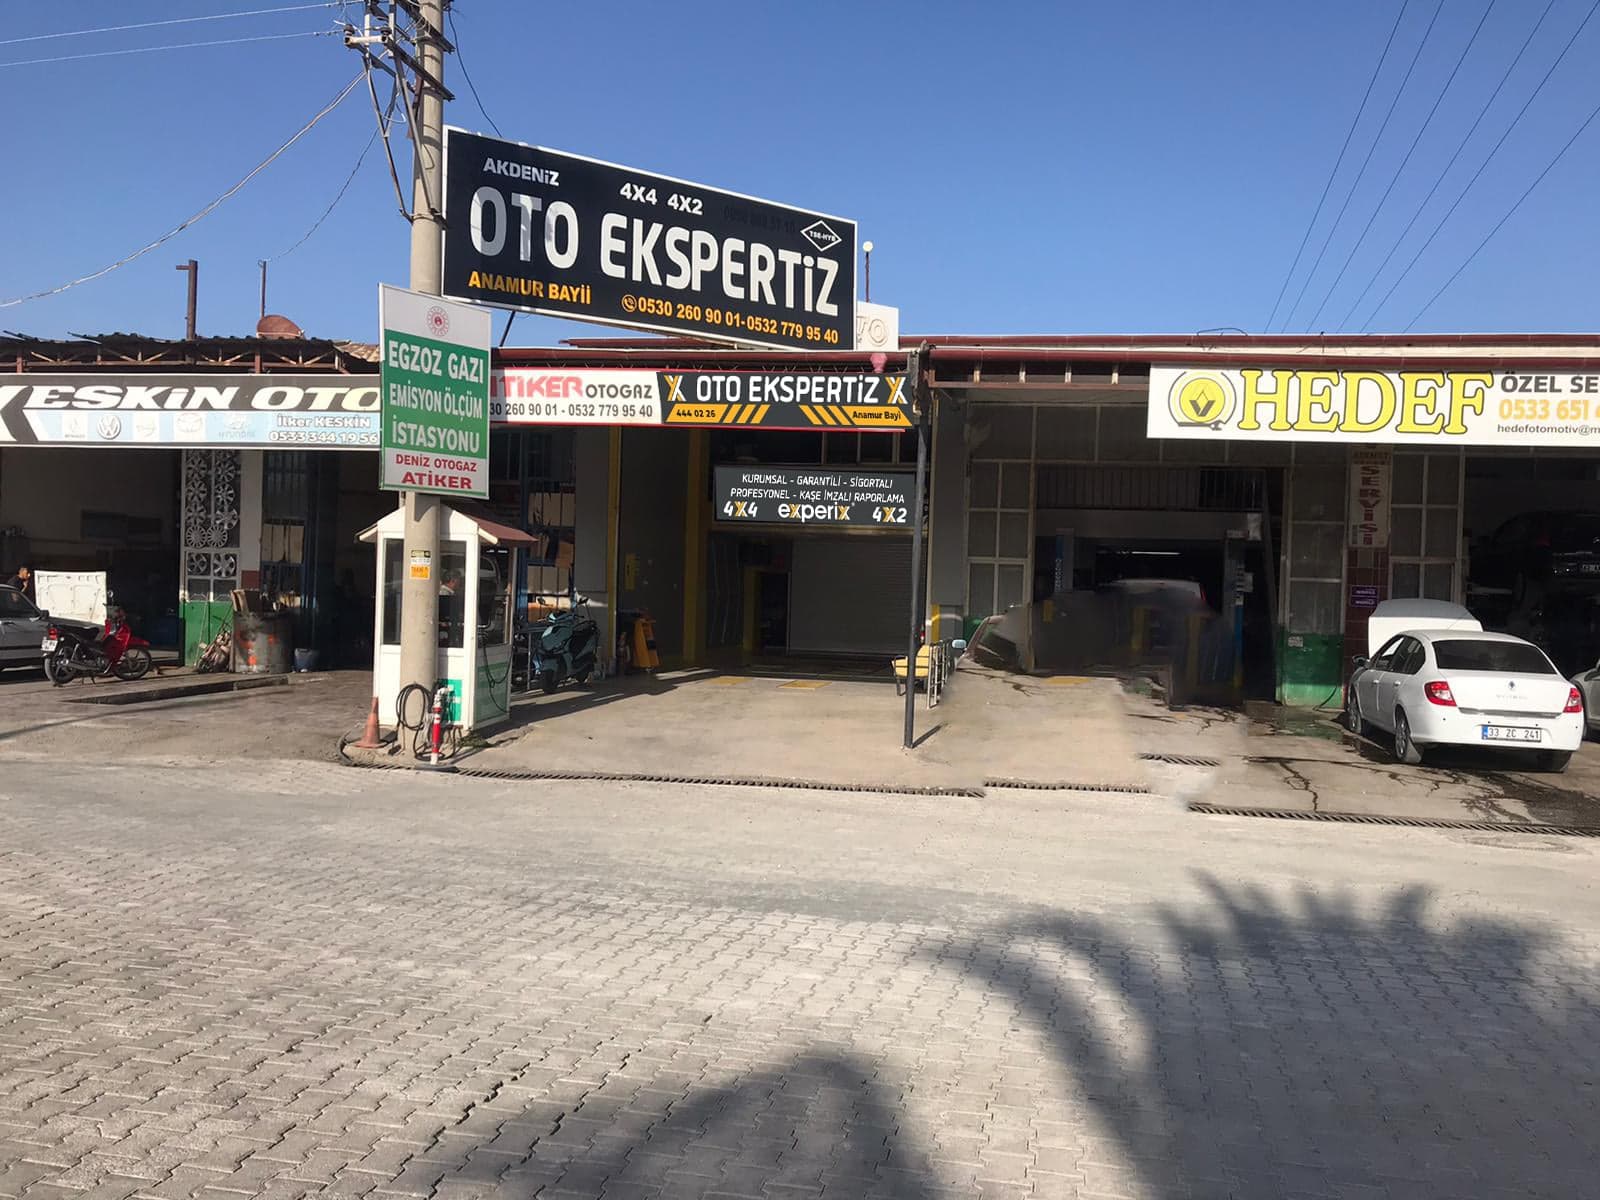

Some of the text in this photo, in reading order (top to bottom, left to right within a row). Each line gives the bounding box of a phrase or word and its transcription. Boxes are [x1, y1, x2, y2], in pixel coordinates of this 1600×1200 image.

[620, 182, 704, 215] 4X4 4X2
[470, 186, 580, 269] OTO
[468, 270, 544, 298] ANAMUR
[637, 296, 673, 317] 0530
[676, 303, 701, 321] 260
[705, 308, 722, 325] 90
[780, 321, 803, 339] 779
[806, 325, 821, 342] 95
[823, 329, 839, 344] 40
[388, 340, 484, 384] EGZOZ GAZI
[585, 384, 653, 399] OTOGAZ
[696, 375, 741, 402] OTO
[1500, 371, 1562, 393] ÖZEL
[251, 386, 380, 411] OTO
[389, 379, 482, 422] EMİSYON ÖLÇÜM
[1237, 367, 1495, 435] HEDEF
[505, 403, 525, 416] 260
[528, 403, 542, 416] 90
[545, 403, 558, 416] 01
[568, 403, 595, 417] 0532
[599, 404, 619, 417] 779
[622, 404, 636, 417] 95
[639, 405, 653, 417] 40
[676, 409, 716, 418] 444 02 26
[852, 410, 883, 419] Anamur
[1499, 399, 1551, 420] 0533
[1556, 399, 1590, 420] 651
[314, 414, 371, 428] KESKİN
[269, 431, 378, 443] 0533 344 19 56
[392, 414, 480, 453] İSTASYONU
[395, 453, 477, 472] DENİZ OTOGAZ
[402, 470, 472, 489] ATİKER
[742, 473, 788, 485] KURUMSAL
[850, 475, 893, 489] SİGORTALI
[730, 487, 790, 500] PROFESYONEL
[799, 490, 822, 503] KAŞE
[823, 489, 852, 502] İMZALI
[854, 491, 905, 504] RAPORLAMA
[723, 500, 908, 523] 4X4 experix 4X2
[1488, 727, 1539, 740] 33 ZC 241
